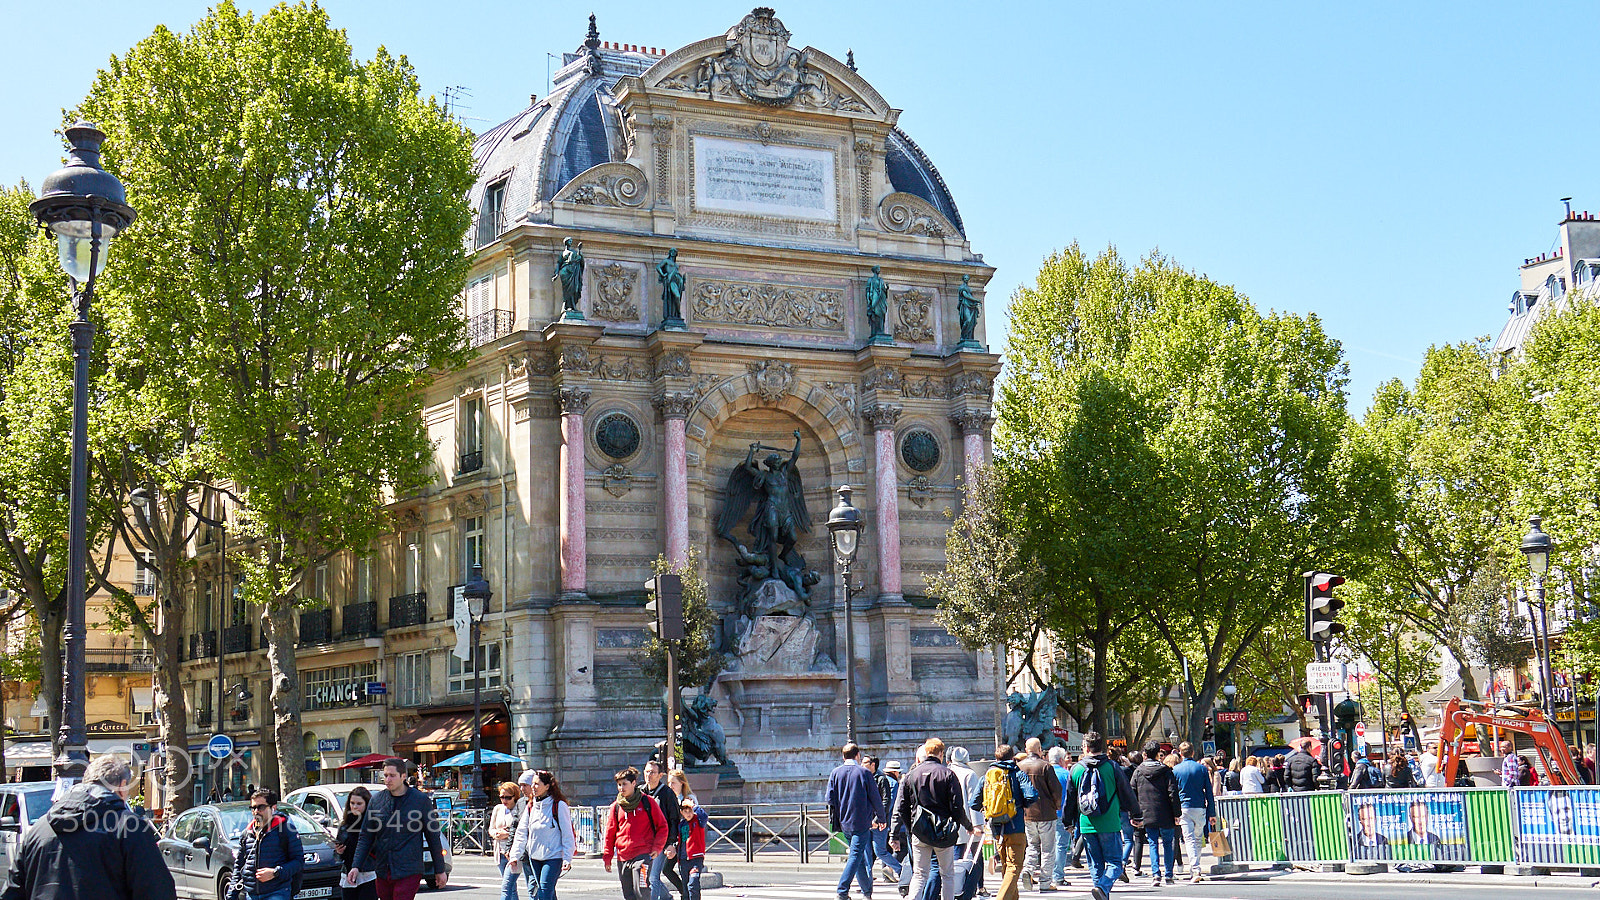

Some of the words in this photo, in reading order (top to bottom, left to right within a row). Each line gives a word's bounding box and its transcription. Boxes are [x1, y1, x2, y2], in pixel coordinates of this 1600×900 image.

[315, 683, 359, 704] CHANGE
[1491, 718, 1525, 728] HITACHI
[319, 739, 339, 751] Change
